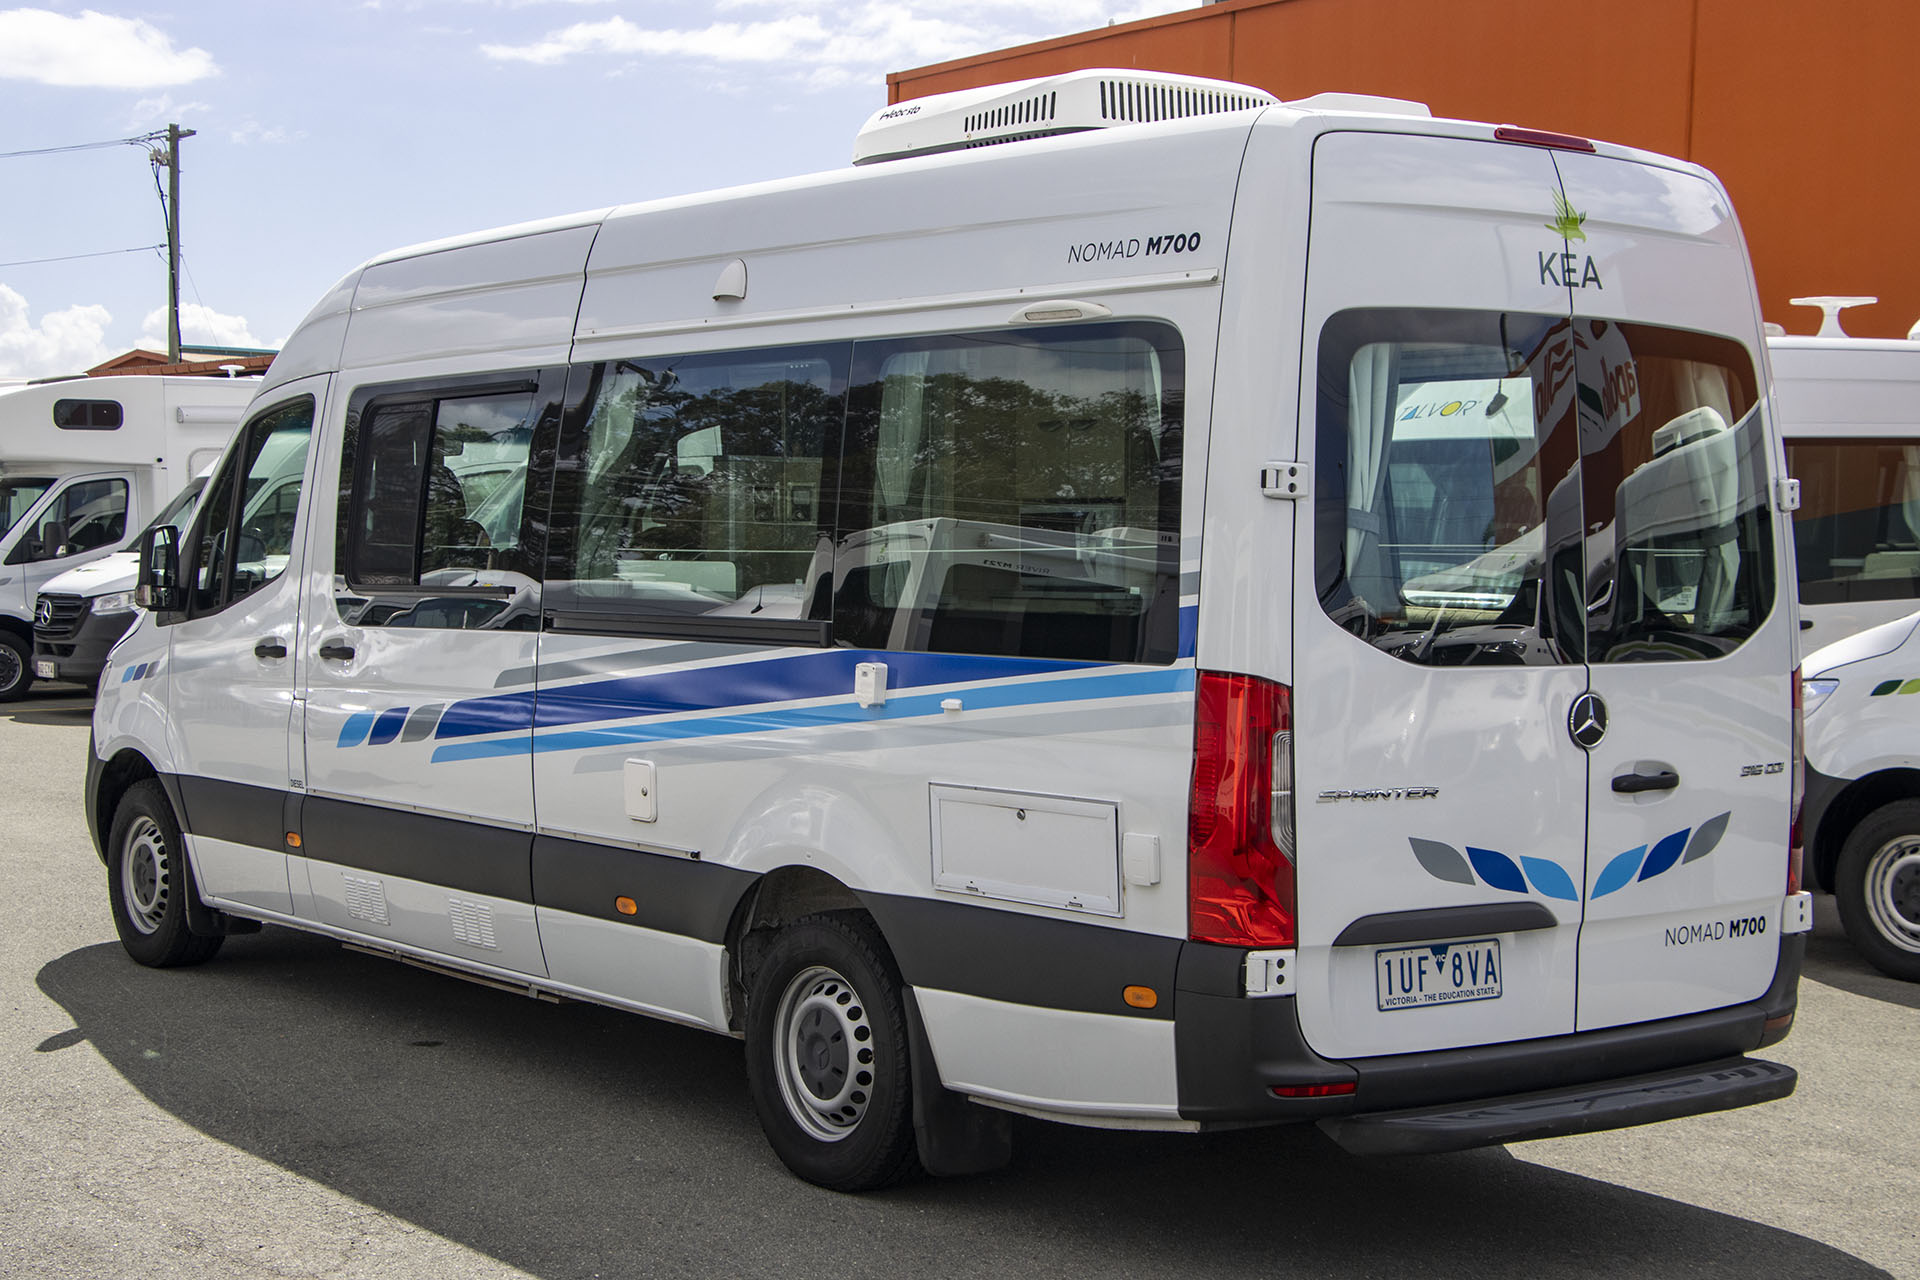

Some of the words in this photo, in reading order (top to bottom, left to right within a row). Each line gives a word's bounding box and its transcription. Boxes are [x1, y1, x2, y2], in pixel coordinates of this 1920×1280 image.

[1067, 238, 1140, 264] NOMAD
[1145, 231, 1201, 256] M700
[1538, 250, 1603, 290] KEA
[1317, 786, 1440, 803] SPRINTER
[1665, 921, 1725, 947] NOMAD
[1729, 915, 1766, 939] M700
[1384, 955, 1429, 996] 1UF
[1451, 948, 1498, 988] 8VA
[1385, 995, 1418, 1006] VICTORIA
[1424, 992, 1437, 1003] THE
[1438, 988, 1475, 1001] EDUCATION
[1476, 986, 1495, 998] STATE
